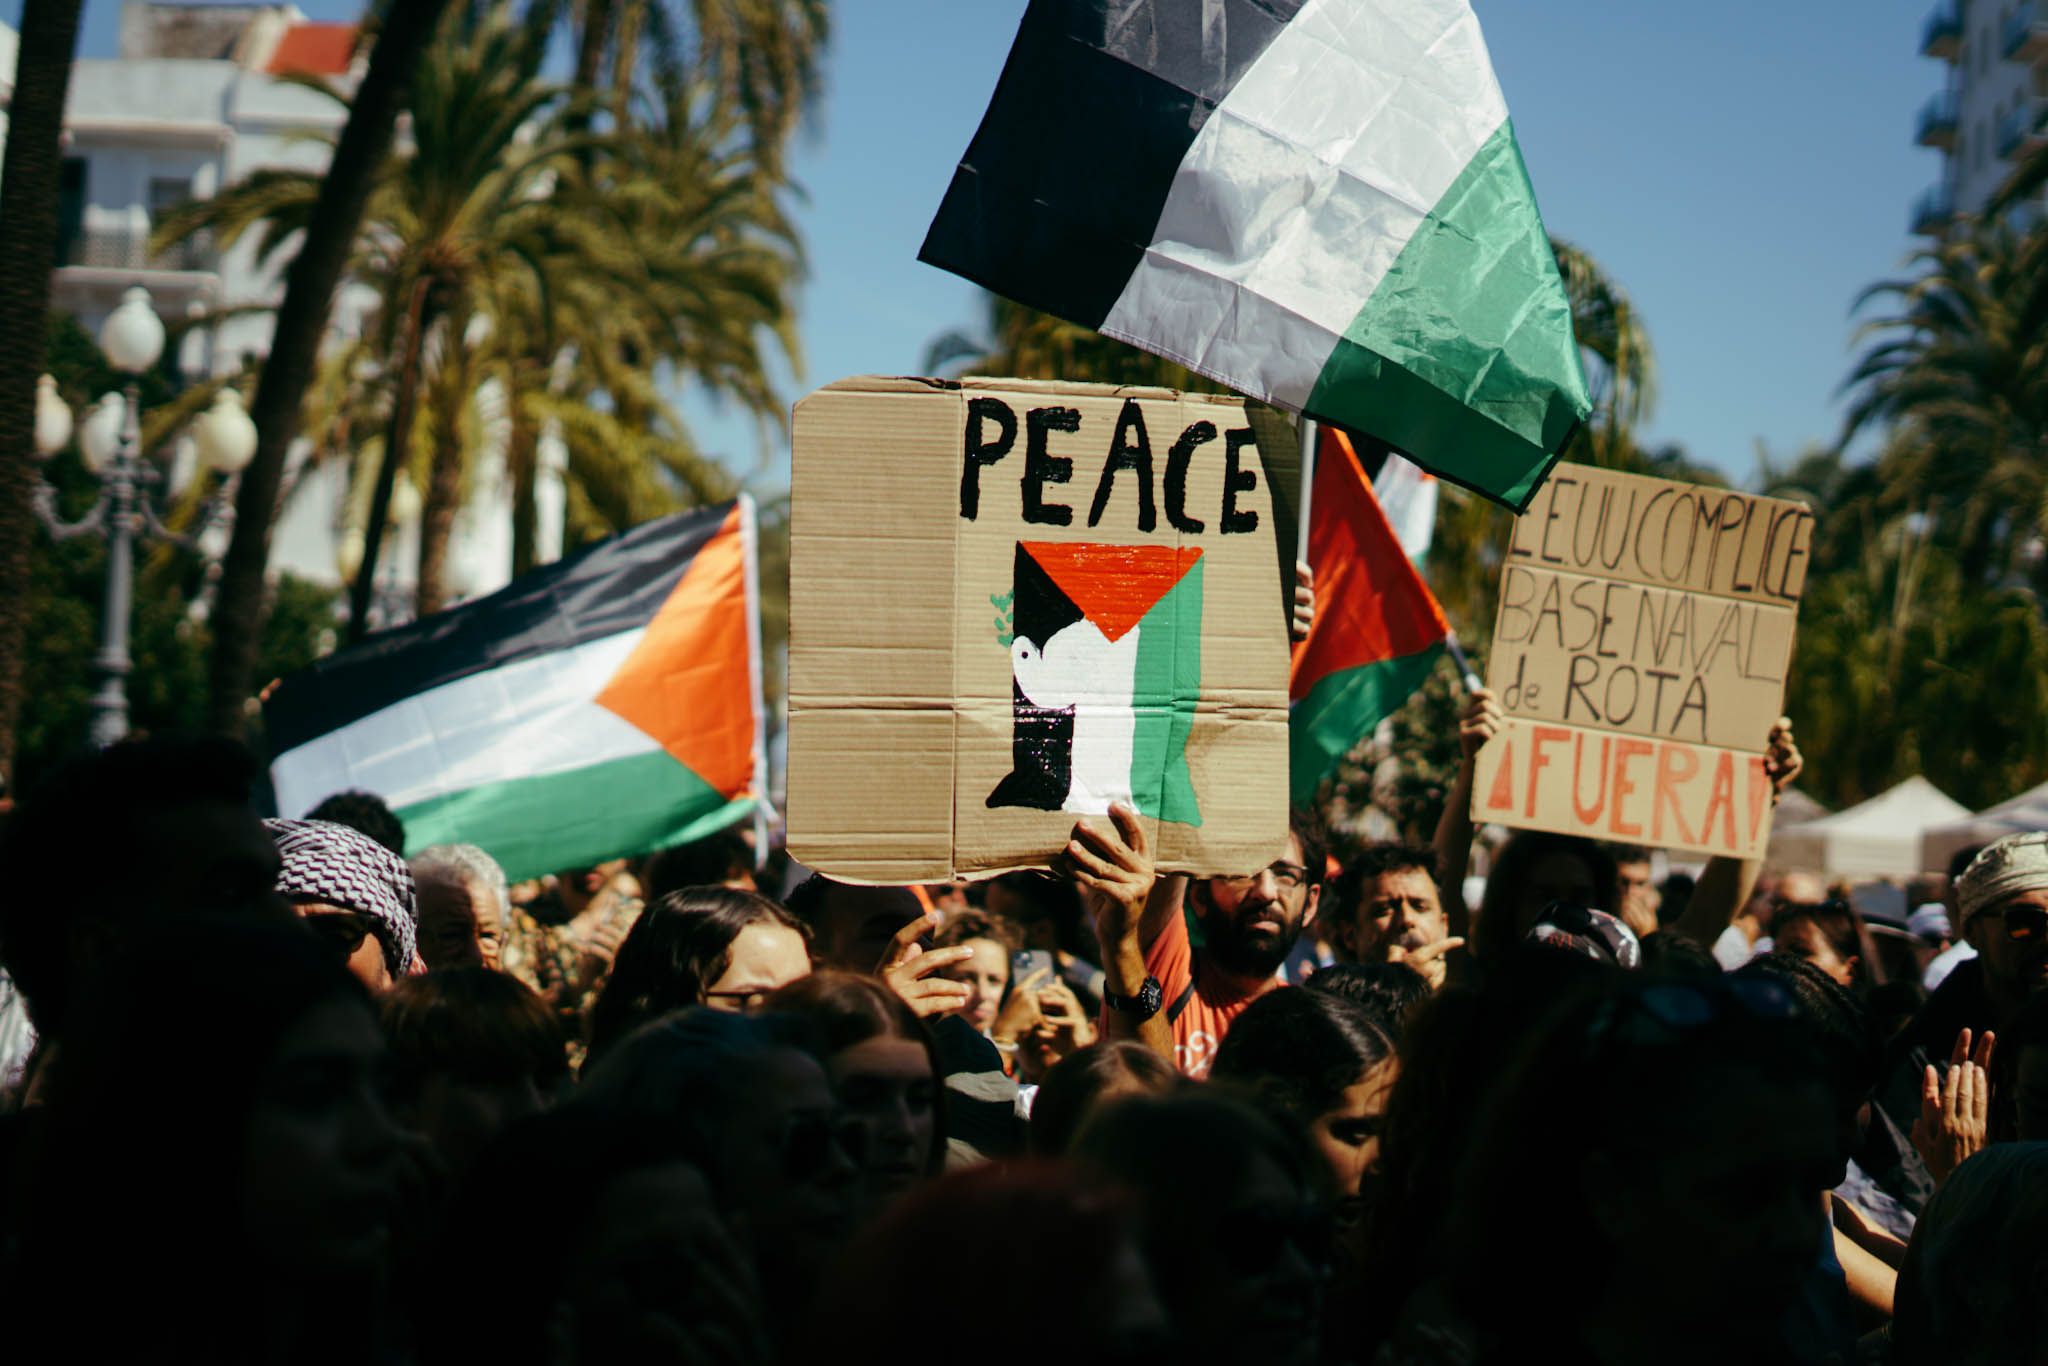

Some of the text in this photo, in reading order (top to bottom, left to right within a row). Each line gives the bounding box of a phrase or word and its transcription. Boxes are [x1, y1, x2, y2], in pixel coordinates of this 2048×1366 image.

[960, 396, 1259, 534] PEACE
[1496, 566, 1782, 684] BASE NAVAL
[1503, 653, 1708, 744] de ROTA
[1486, 722, 1769, 852] ¡FUERA!
